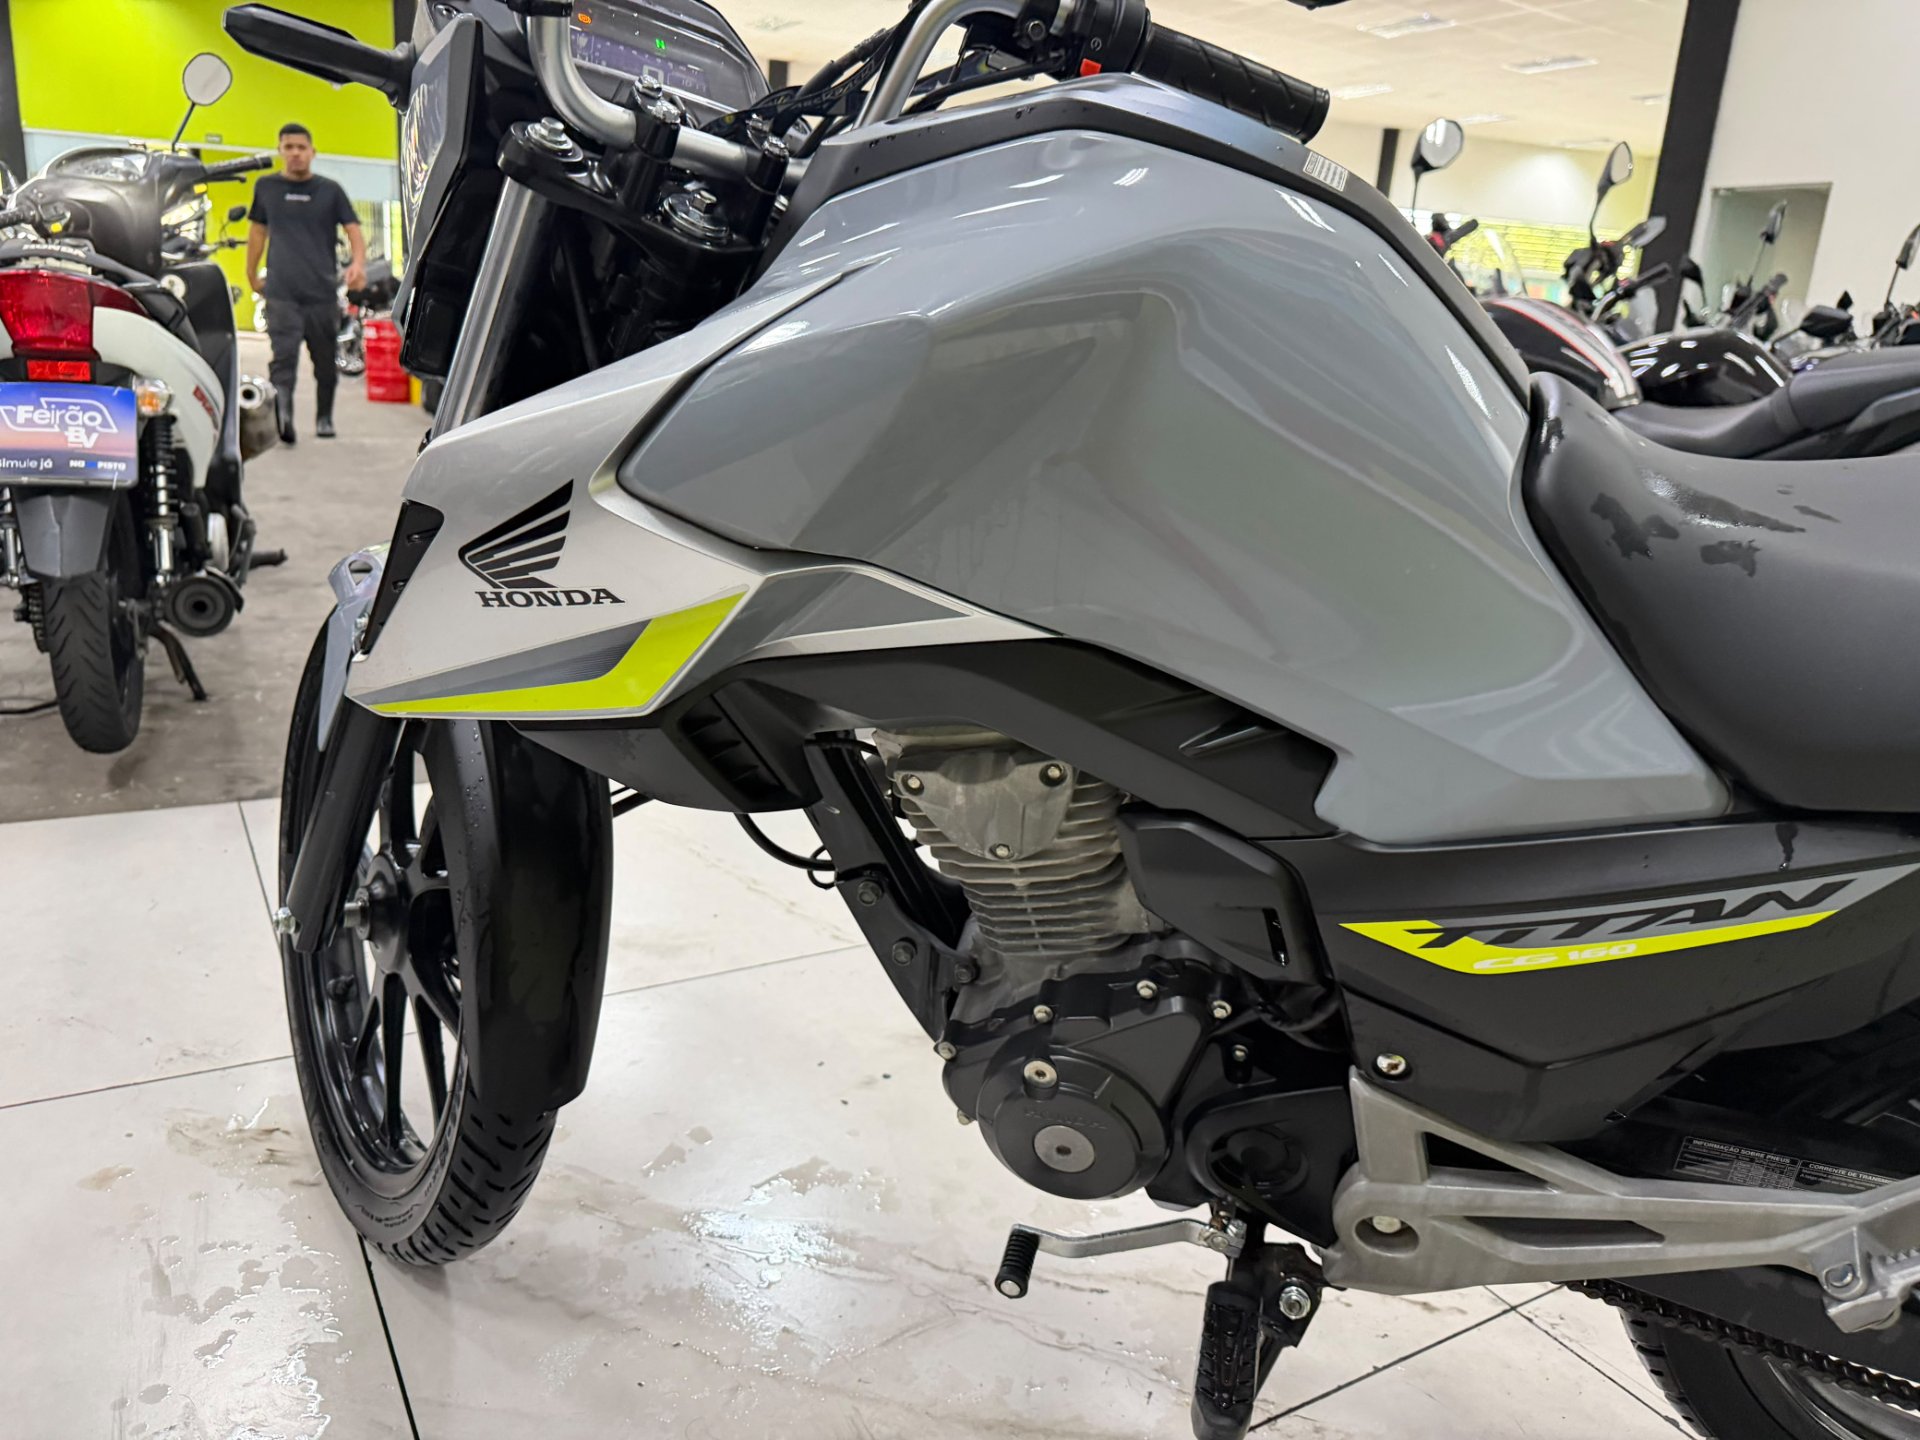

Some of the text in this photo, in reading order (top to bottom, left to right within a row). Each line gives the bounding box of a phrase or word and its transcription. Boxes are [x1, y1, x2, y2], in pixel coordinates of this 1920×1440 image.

[16, 404, 103, 427] Feirão
[474, 588, 626, 608] HONDA
[1403, 878, 1858, 949] TITAN
[1472, 943, 1637, 970] CG 160
